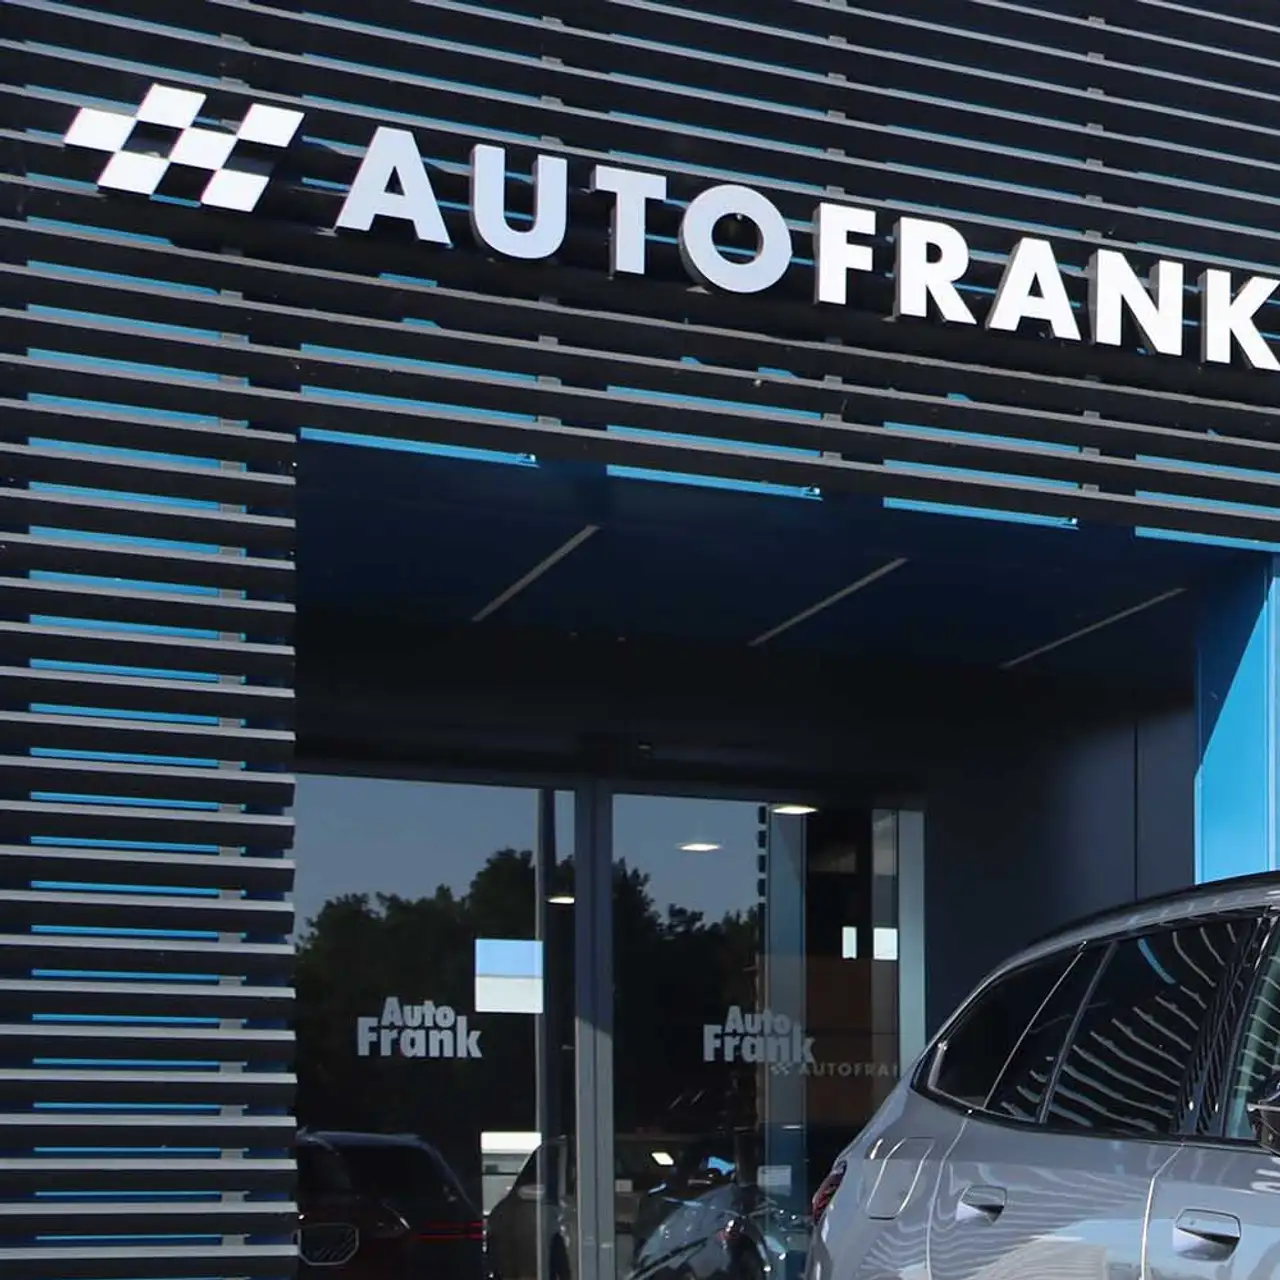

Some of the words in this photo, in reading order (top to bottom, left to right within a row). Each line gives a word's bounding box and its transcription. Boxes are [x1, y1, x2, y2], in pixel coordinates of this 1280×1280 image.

[381, 996, 456, 1028] Auto
[724, 1005, 792, 1036] Auto
[357, 1015, 483, 1058] Frank
[702, 1022, 815, 1064] Frank
[800, 1061, 898, 1078] AUTOFRA
